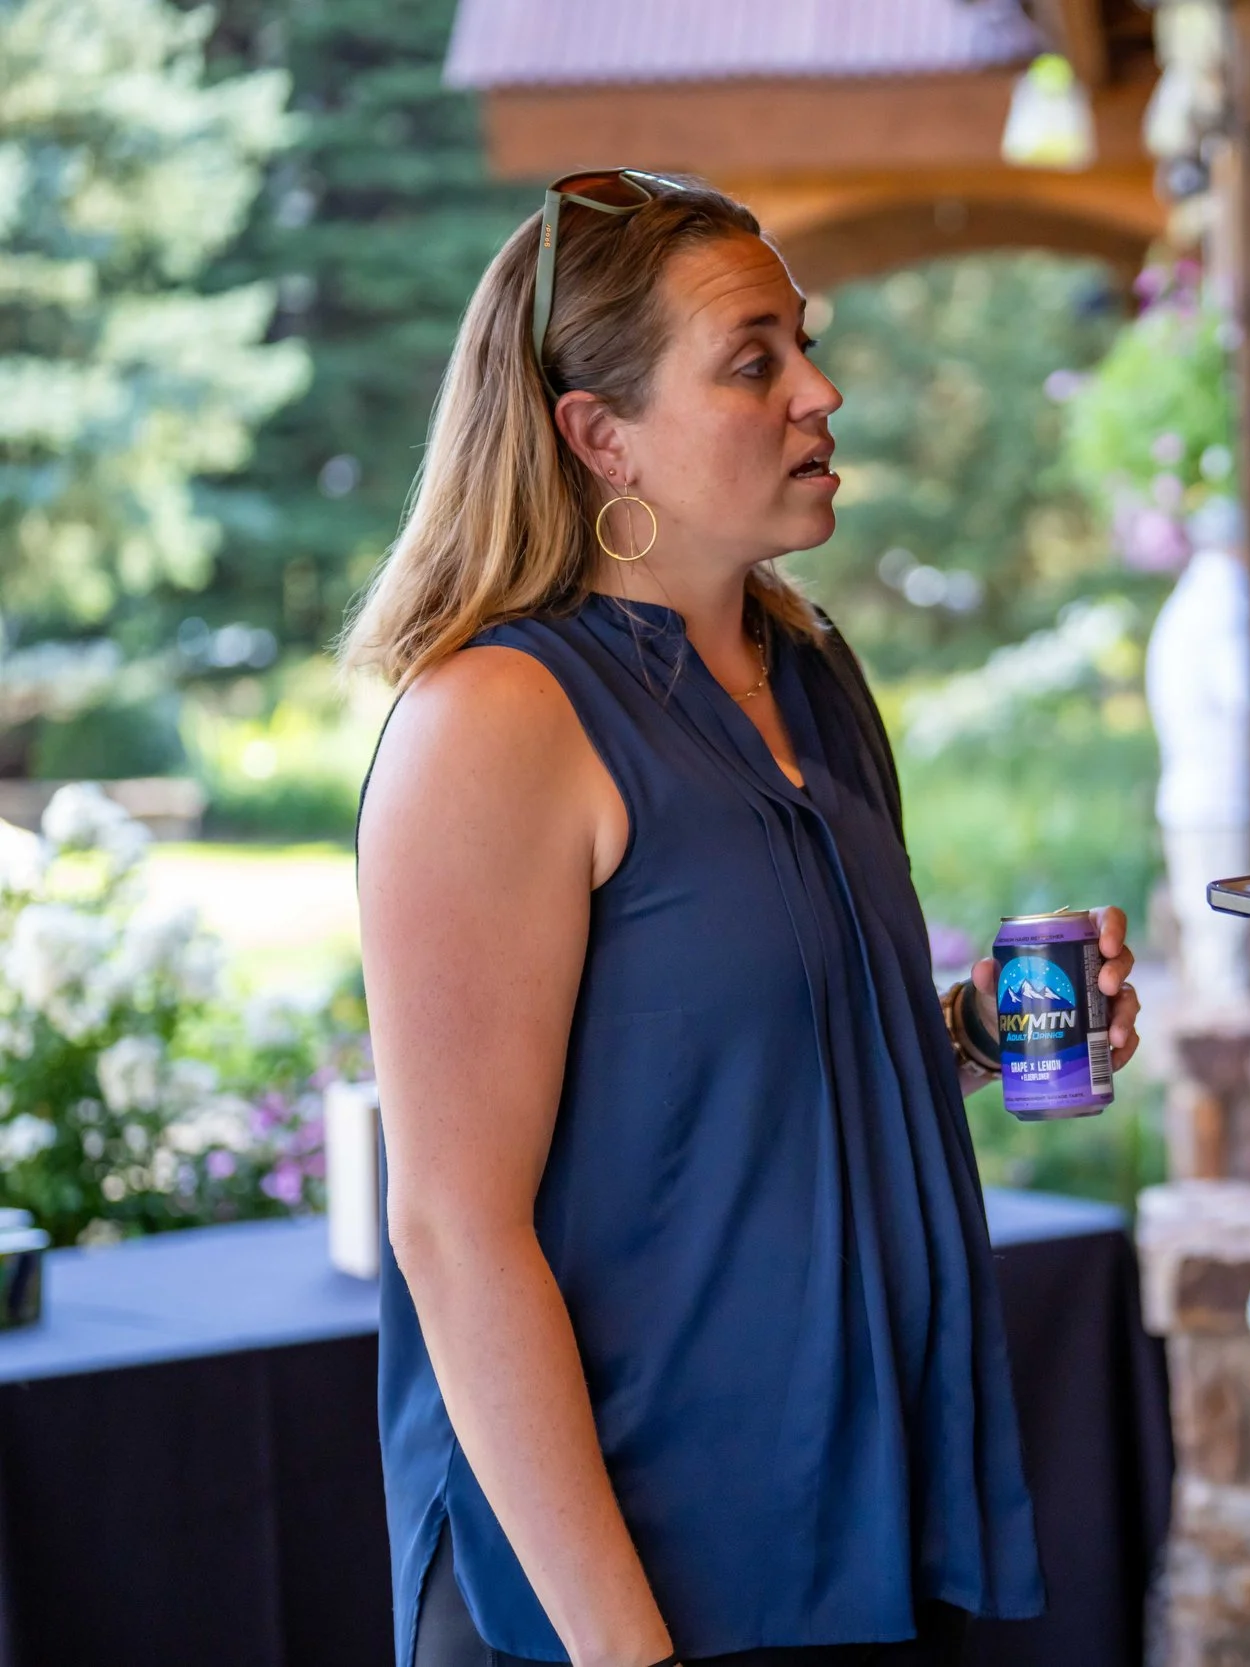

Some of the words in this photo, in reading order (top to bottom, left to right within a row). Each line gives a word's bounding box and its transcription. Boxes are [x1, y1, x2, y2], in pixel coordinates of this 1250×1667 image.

[1000, 1010, 1076, 1038] RKYMTN
[1006, 1033, 1028, 1041] ADULT
[1032, 1031, 1064, 1040] DRINKS
[1011, 1061, 1027, 1073] GRAPE
[1037, 1059, 1061, 1072] LEMON
